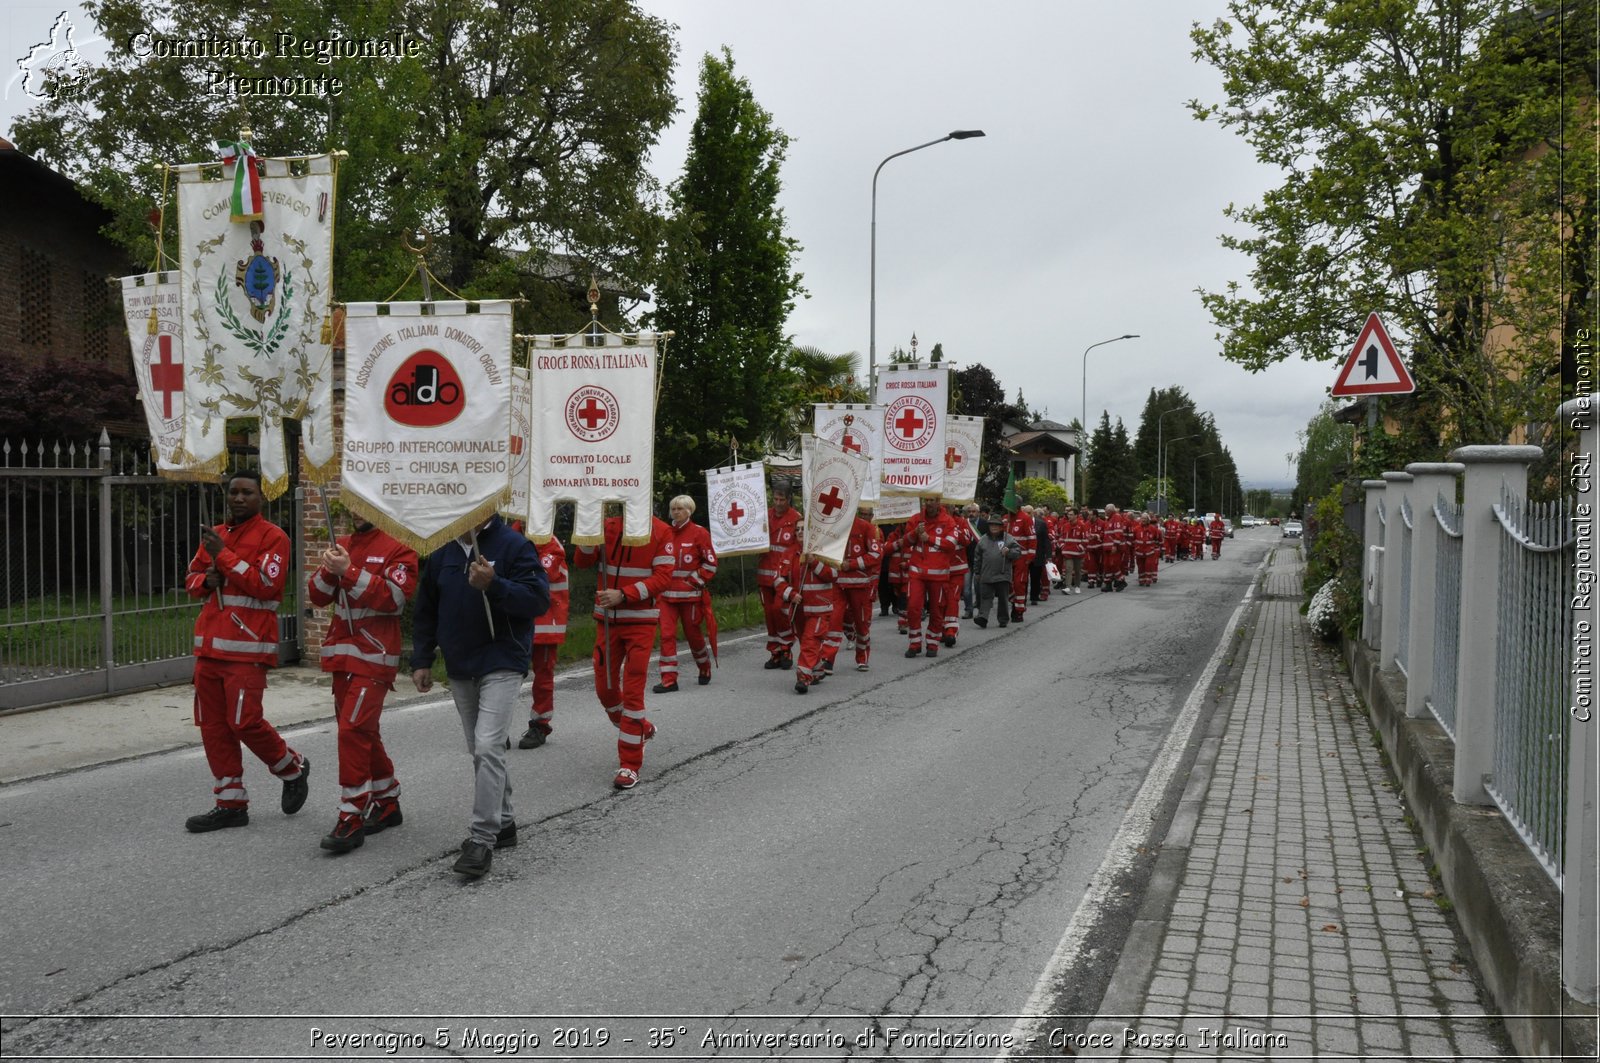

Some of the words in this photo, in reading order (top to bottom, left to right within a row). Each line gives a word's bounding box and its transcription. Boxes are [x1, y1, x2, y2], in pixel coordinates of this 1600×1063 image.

[355, 333, 396, 389] ASSOCIAZIONE
[397, 325, 439, 342] ITALIANA
[444, 326, 484, 354] DONATORI
[479, 353, 503, 386] ORGANI
[537, 355, 569, 370] CROCE
[570, 355, 600, 370] ROSSA
[602, 353, 648, 369] ITALIANA
[886, 381, 900, 390] CROCE
[901, 381, 916, 389] ROSSA
[917, 380, 937, 389] ITALIANA
[574, 395, 582, 403] DI
[580, 389, 605, 398] GINEVRA
[568, 401, 586, 437] CONVENZIONE
[609, 403, 617, 427] AGOSTO
[887, 398, 913, 430] CONVENZIONE
[922, 404, 935, 429] GINEVRA
[347, 440, 394, 454] GRUPPO
[400, 440, 506, 454] INTERCOMUNALE
[896, 441, 915, 450] AGOSTO
[549, 455, 595, 465] COMITATO
[596, 454, 632, 464] LOCALE
[884, 457, 910, 465] COMITATO
[346, 460, 390, 474] BOVES
[409, 461, 459, 474] CHIUSA
[465, 461, 506, 474] PESIO
[586, 466, 594, 475] DI
[543, 478, 591, 488] SOMMARIVA
[592, 477, 609, 487] DEL
[611, 478, 639, 488] BOSCO
[382, 482, 467, 496] PEVERAGNO
